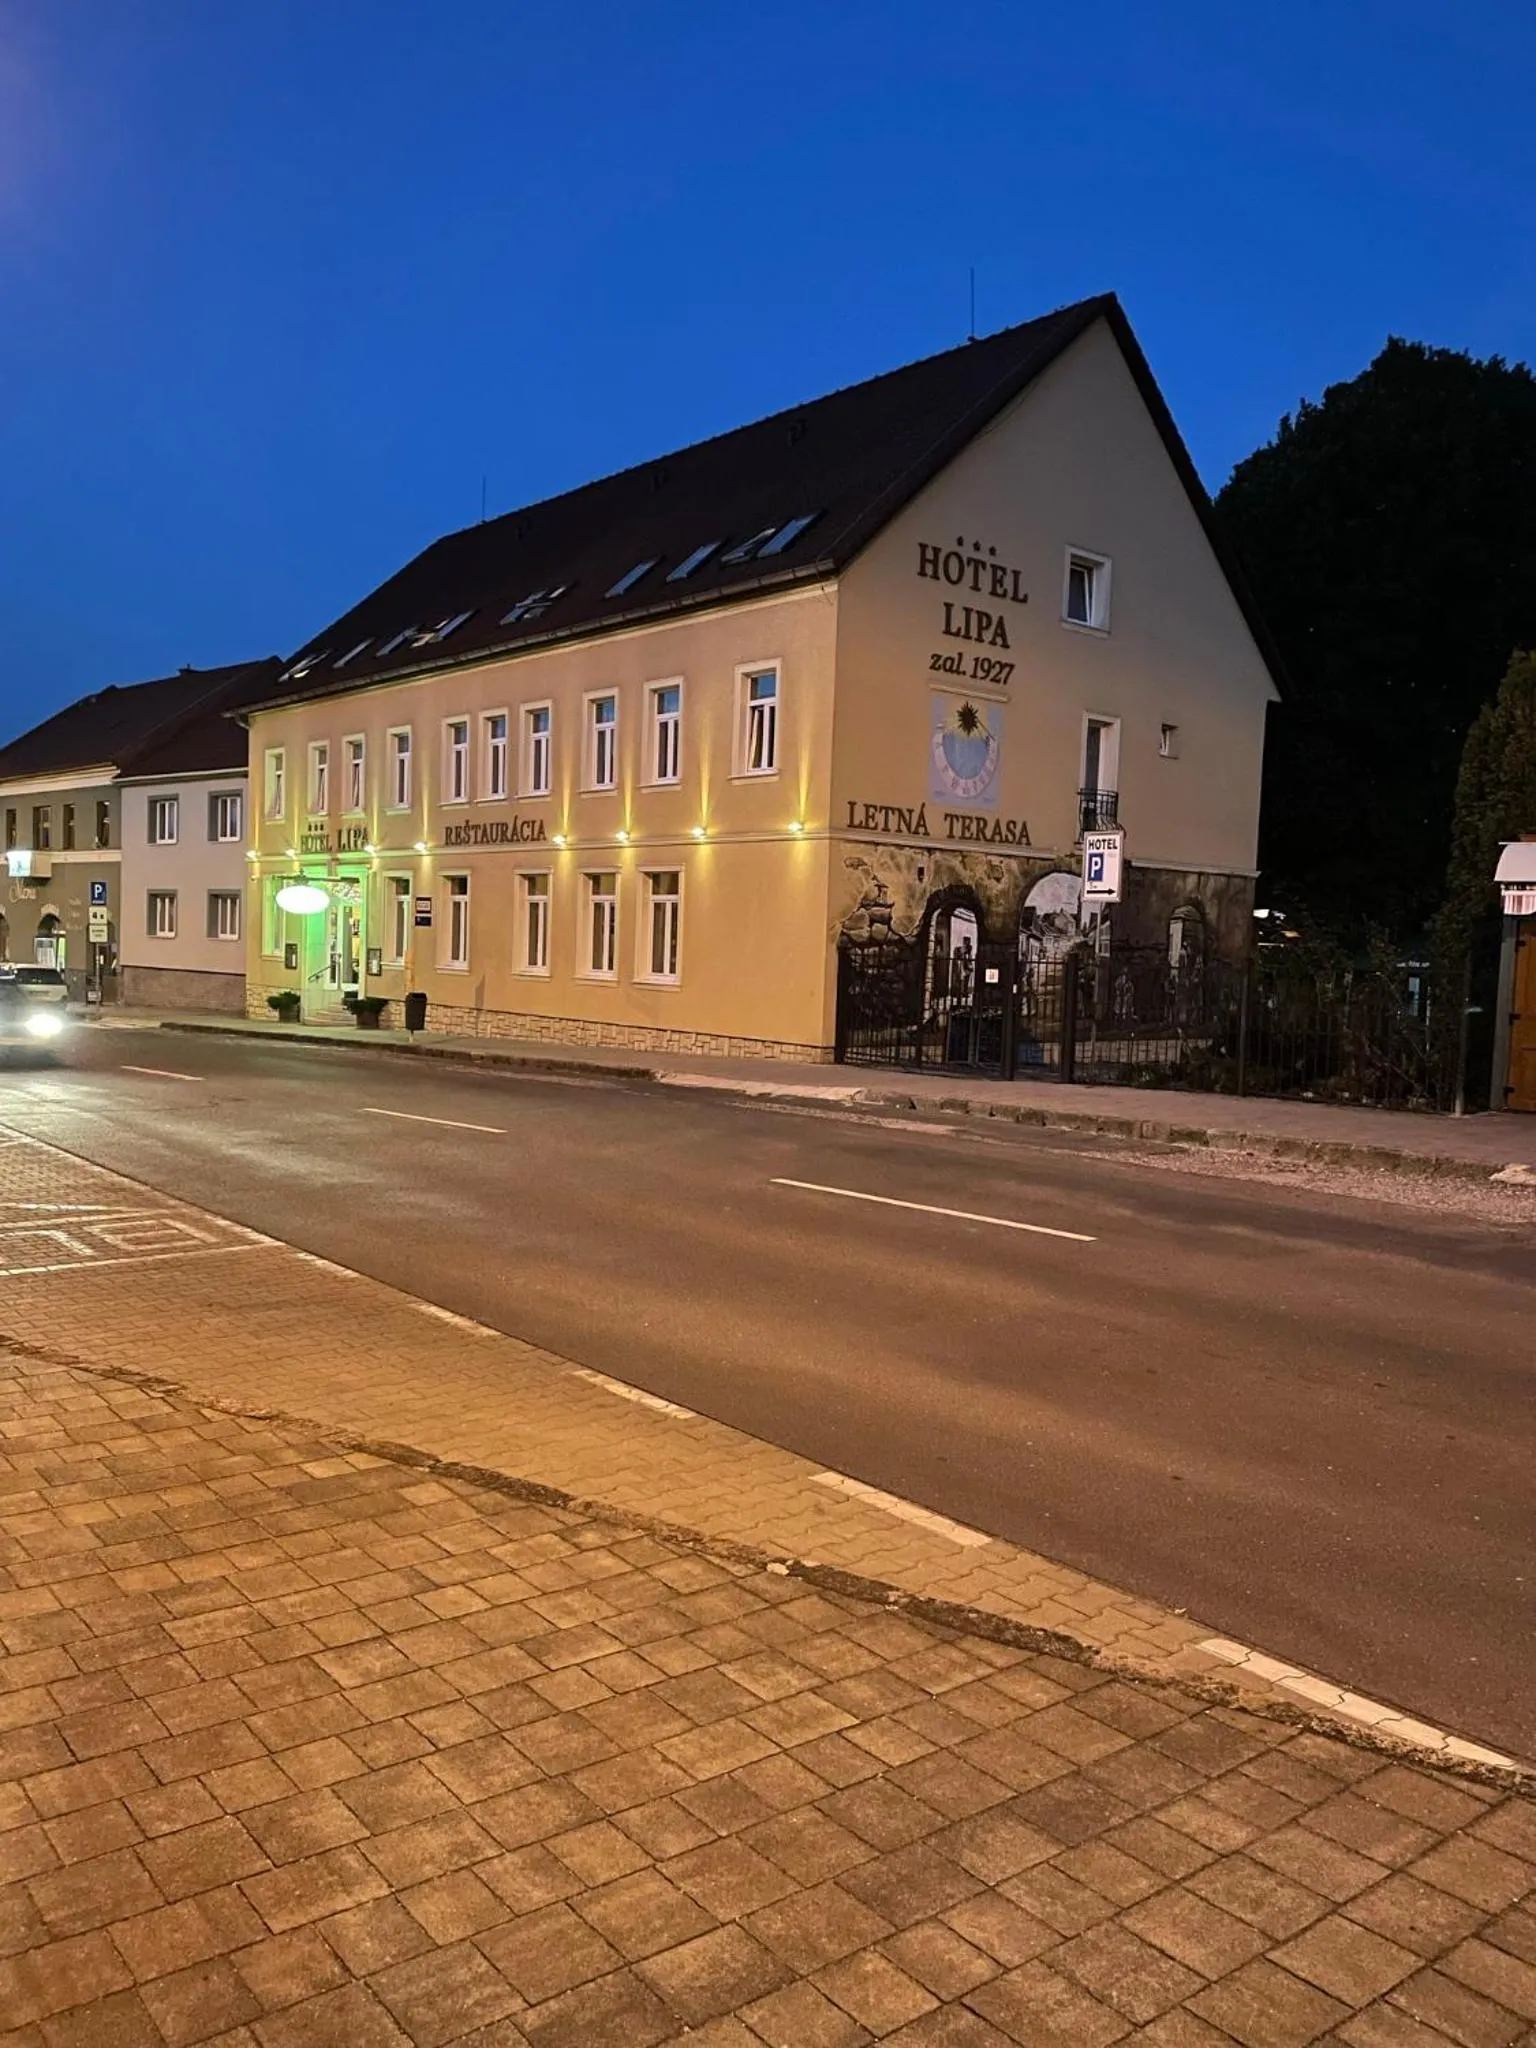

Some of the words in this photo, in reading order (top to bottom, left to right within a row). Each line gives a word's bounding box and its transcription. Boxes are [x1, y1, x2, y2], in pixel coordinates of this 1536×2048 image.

[917, 542, 1029, 604] HOTEL
[942, 602, 1010, 649] LIPA
[929, 652, 967, 676] zal.
[970, 657, 1016, 685] 1927
[301, 834, 333, 852] HOTEL
[337, 827, 368, 850] LIPA
[444, 814, 547, 846] REŠTAURÁCIA
[847, 801, 930, 836] LETNÁ
[944, 813, 1031, 846] TERASA
[1088, 839, 1118, 850] HOTEL
[1091, 856, 1102, 878] P
[94, 884, 103, 898] P
